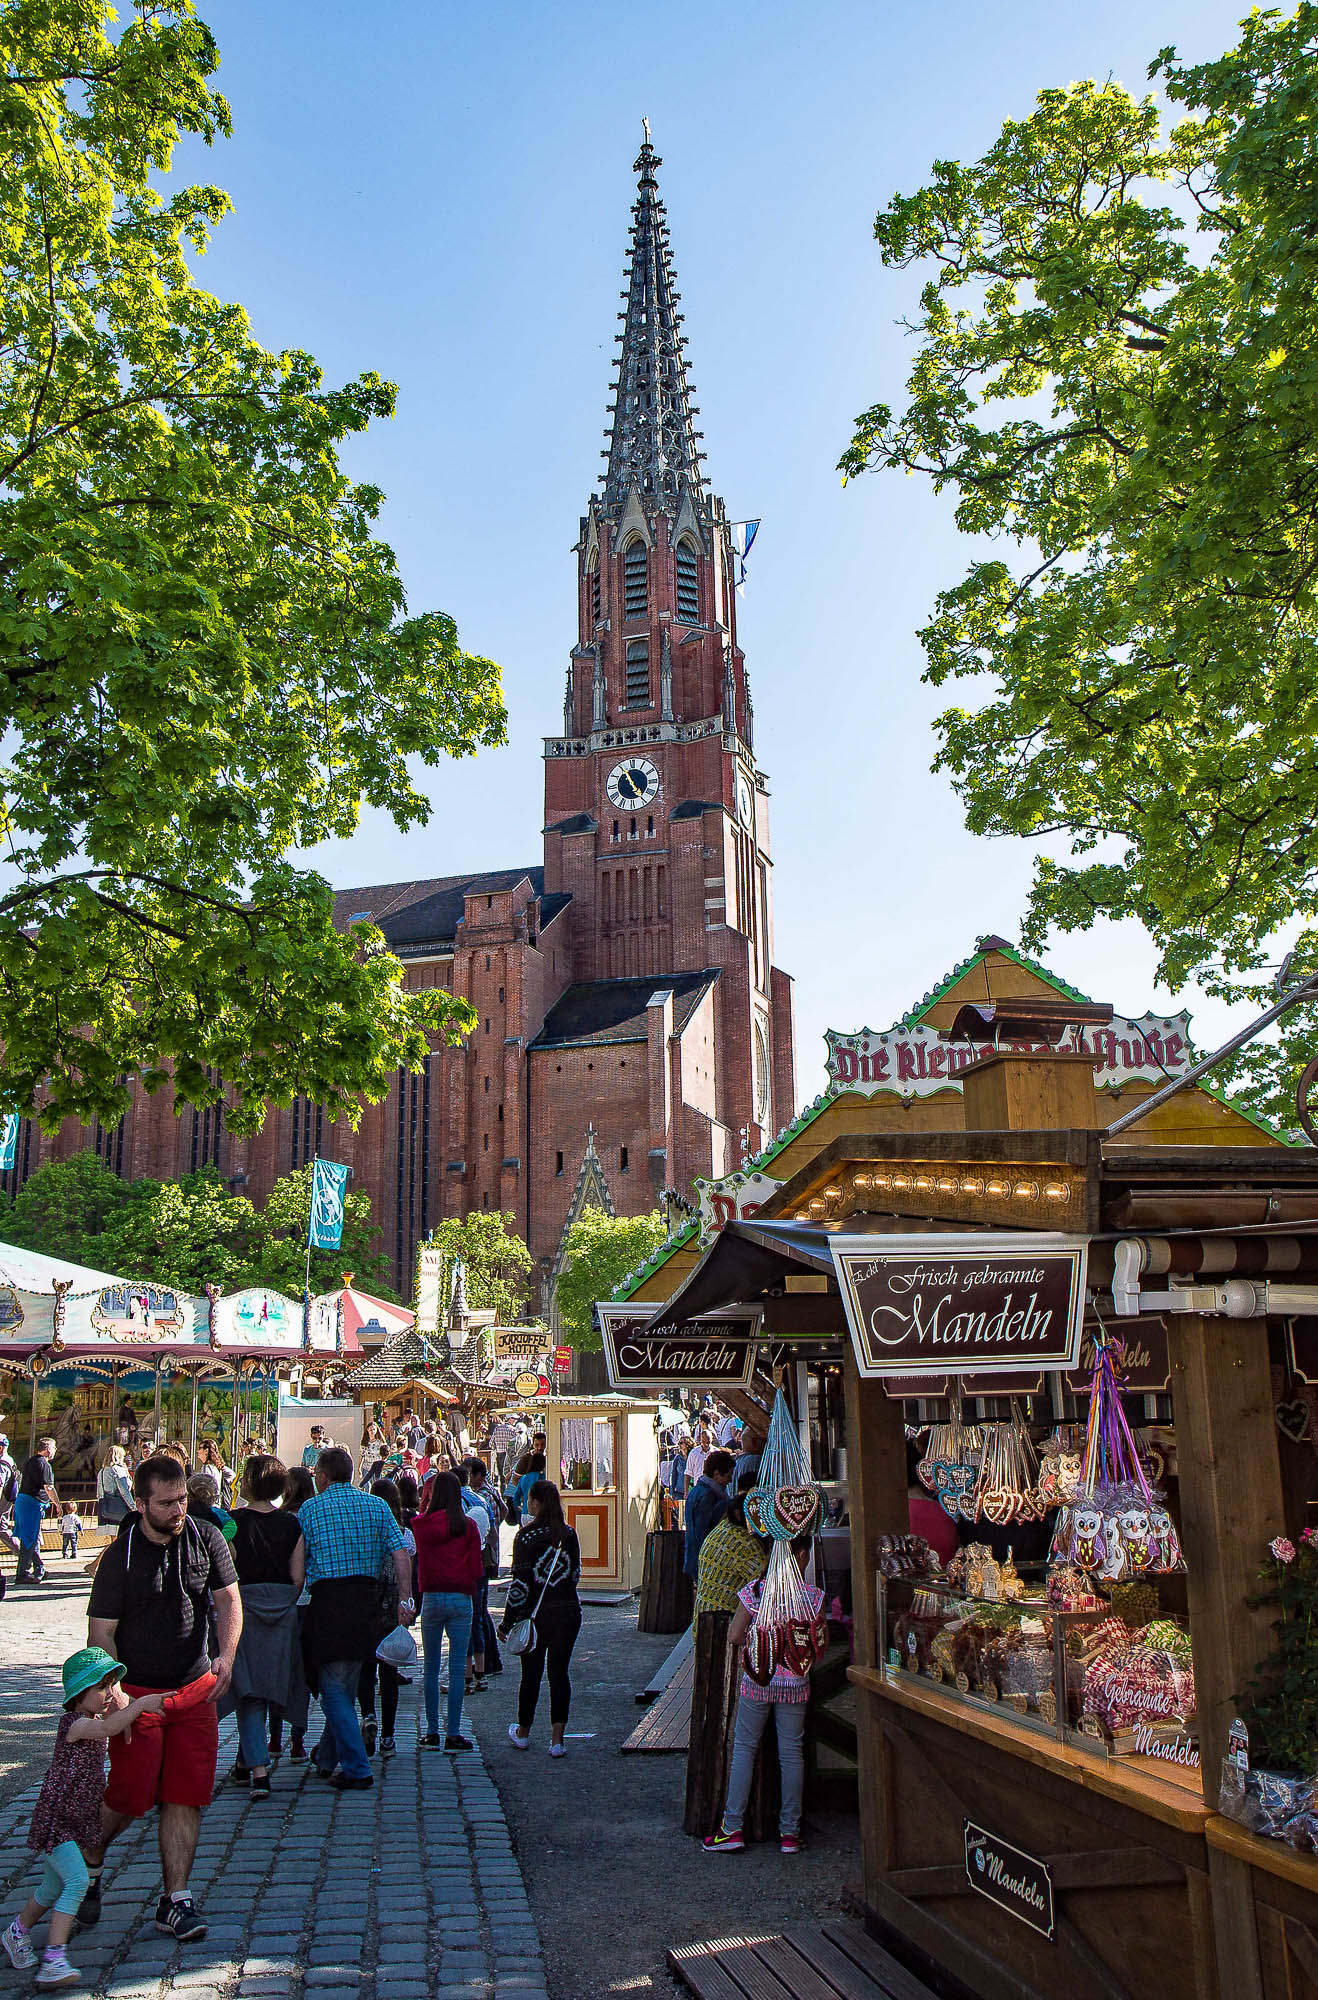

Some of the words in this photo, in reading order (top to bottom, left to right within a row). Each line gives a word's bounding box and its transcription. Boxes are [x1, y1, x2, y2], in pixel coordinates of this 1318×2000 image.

[832, 1041, 890, 1083] Die
[895, 1040, 997, 1082] klein
[961, 1264, 1046, 1293] gebrannte
[870, 1293, 1053, 1345] Mandeln
[498, 1334, 548, 1348] KARTOFFEL
[619, 1341, 737, 1371] Mandeln
[1104, 1673, 1170, 1714] Gebrannte
[1132, 1722, 1200, 1768] Mandeln
[986, 1851, 1045, 1911] Mandeln
